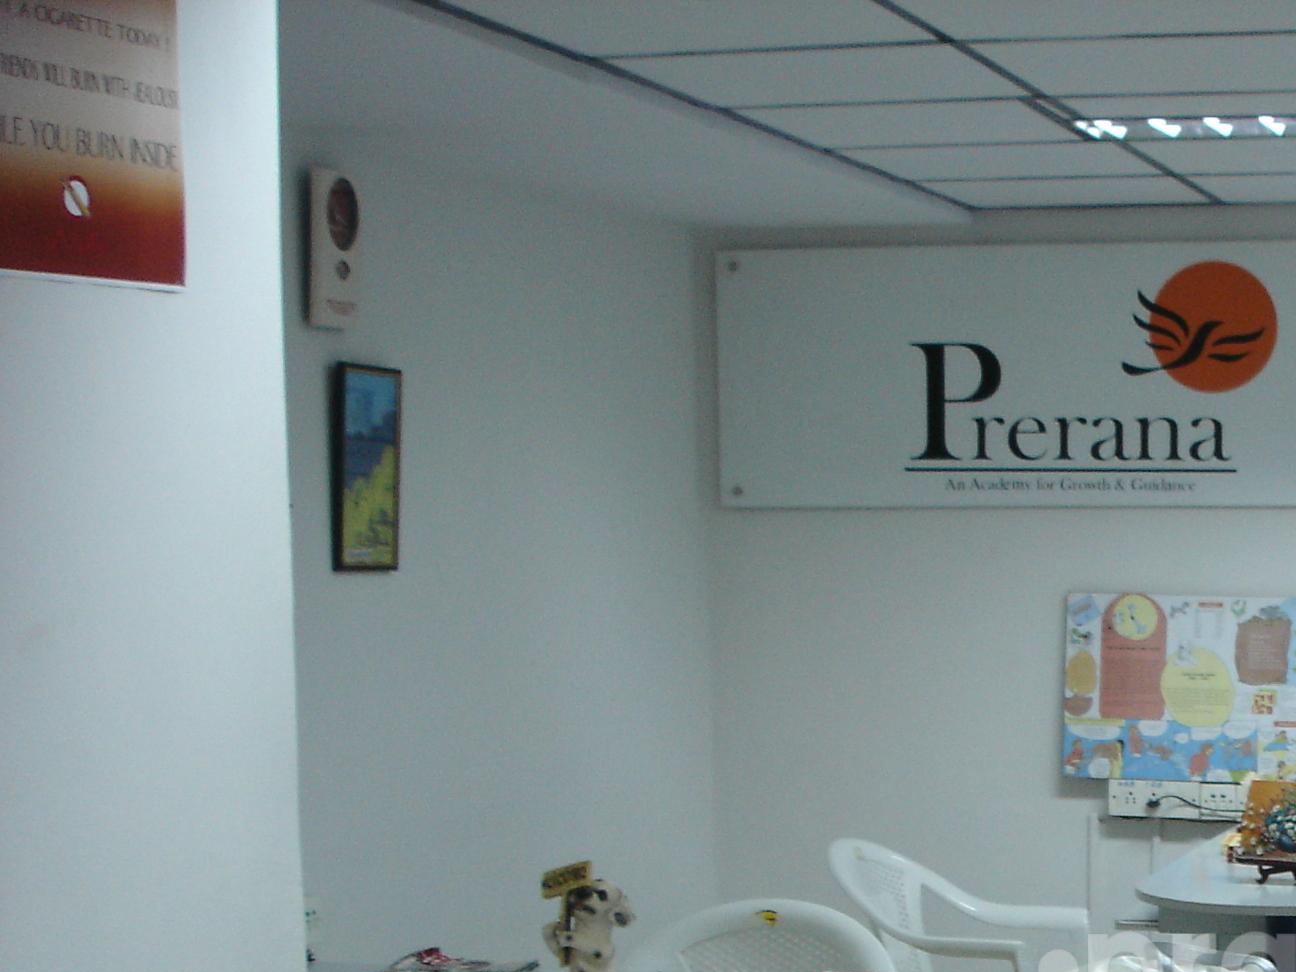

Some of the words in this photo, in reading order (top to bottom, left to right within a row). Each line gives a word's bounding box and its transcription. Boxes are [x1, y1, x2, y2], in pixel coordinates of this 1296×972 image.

[30, 118, 69, 152] YOU
[75, 127, 124, 161] BURN
[909, 341, 1232, 462] Prerana
[945, 478, 966, 491] An
[970, 478, 1031, 493] Academy
[1036, 478, 1055, 491] for
[1060, 478, 1110, 492] Growth
[1114, 478, 1125, 491] &
[1130, 478, 1196, 492] Guidance
